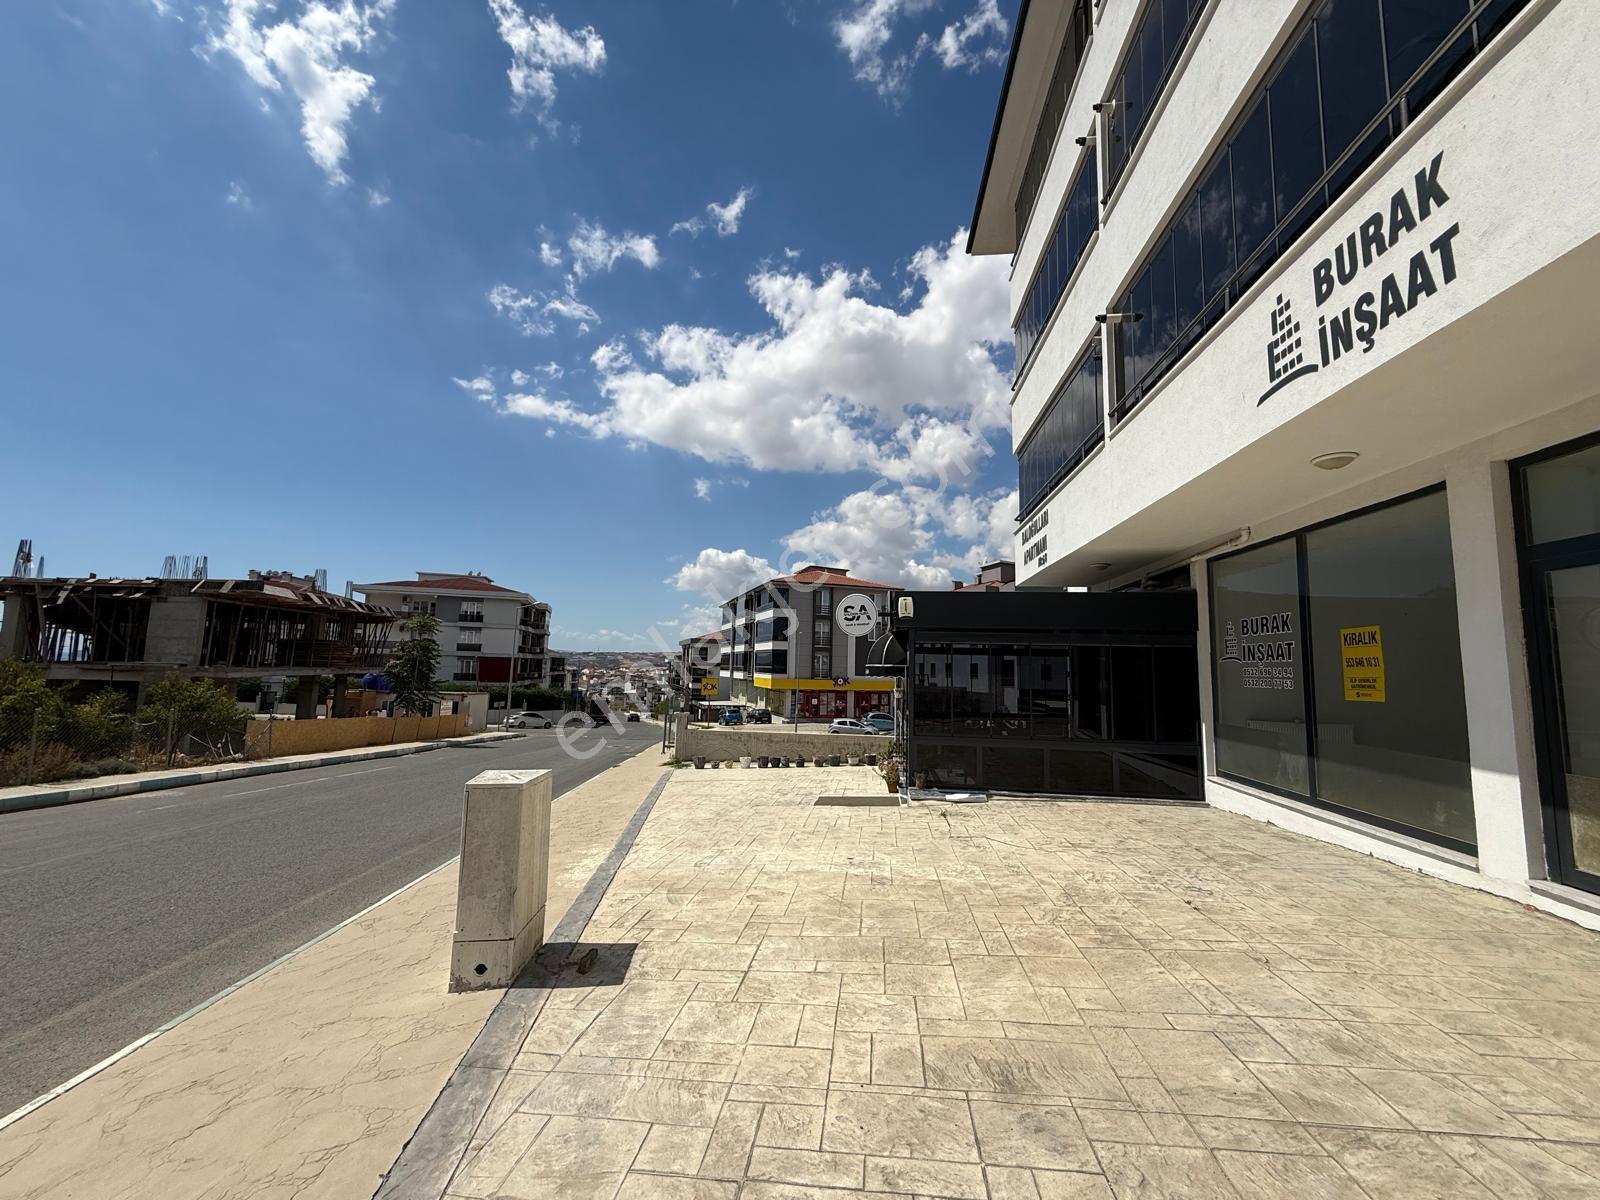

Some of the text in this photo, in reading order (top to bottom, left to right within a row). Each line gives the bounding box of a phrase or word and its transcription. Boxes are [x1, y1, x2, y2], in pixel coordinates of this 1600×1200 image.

[1312, 150, 1450, 308] BURAK
[1317, 222, 1460, 368] İNŞAAT
[1241, 612, 1293, 637] BURAK
[1241, 640, 1295, 667] İNŞAAT
[1243, 679, 1259, 688] 0532
[1283, 680, 1294, 690] 53
[1259, 667, 1272, 677] 696
[1272, 667, 1282, 677] 34
[1283, 667, 1294, 677] 94
